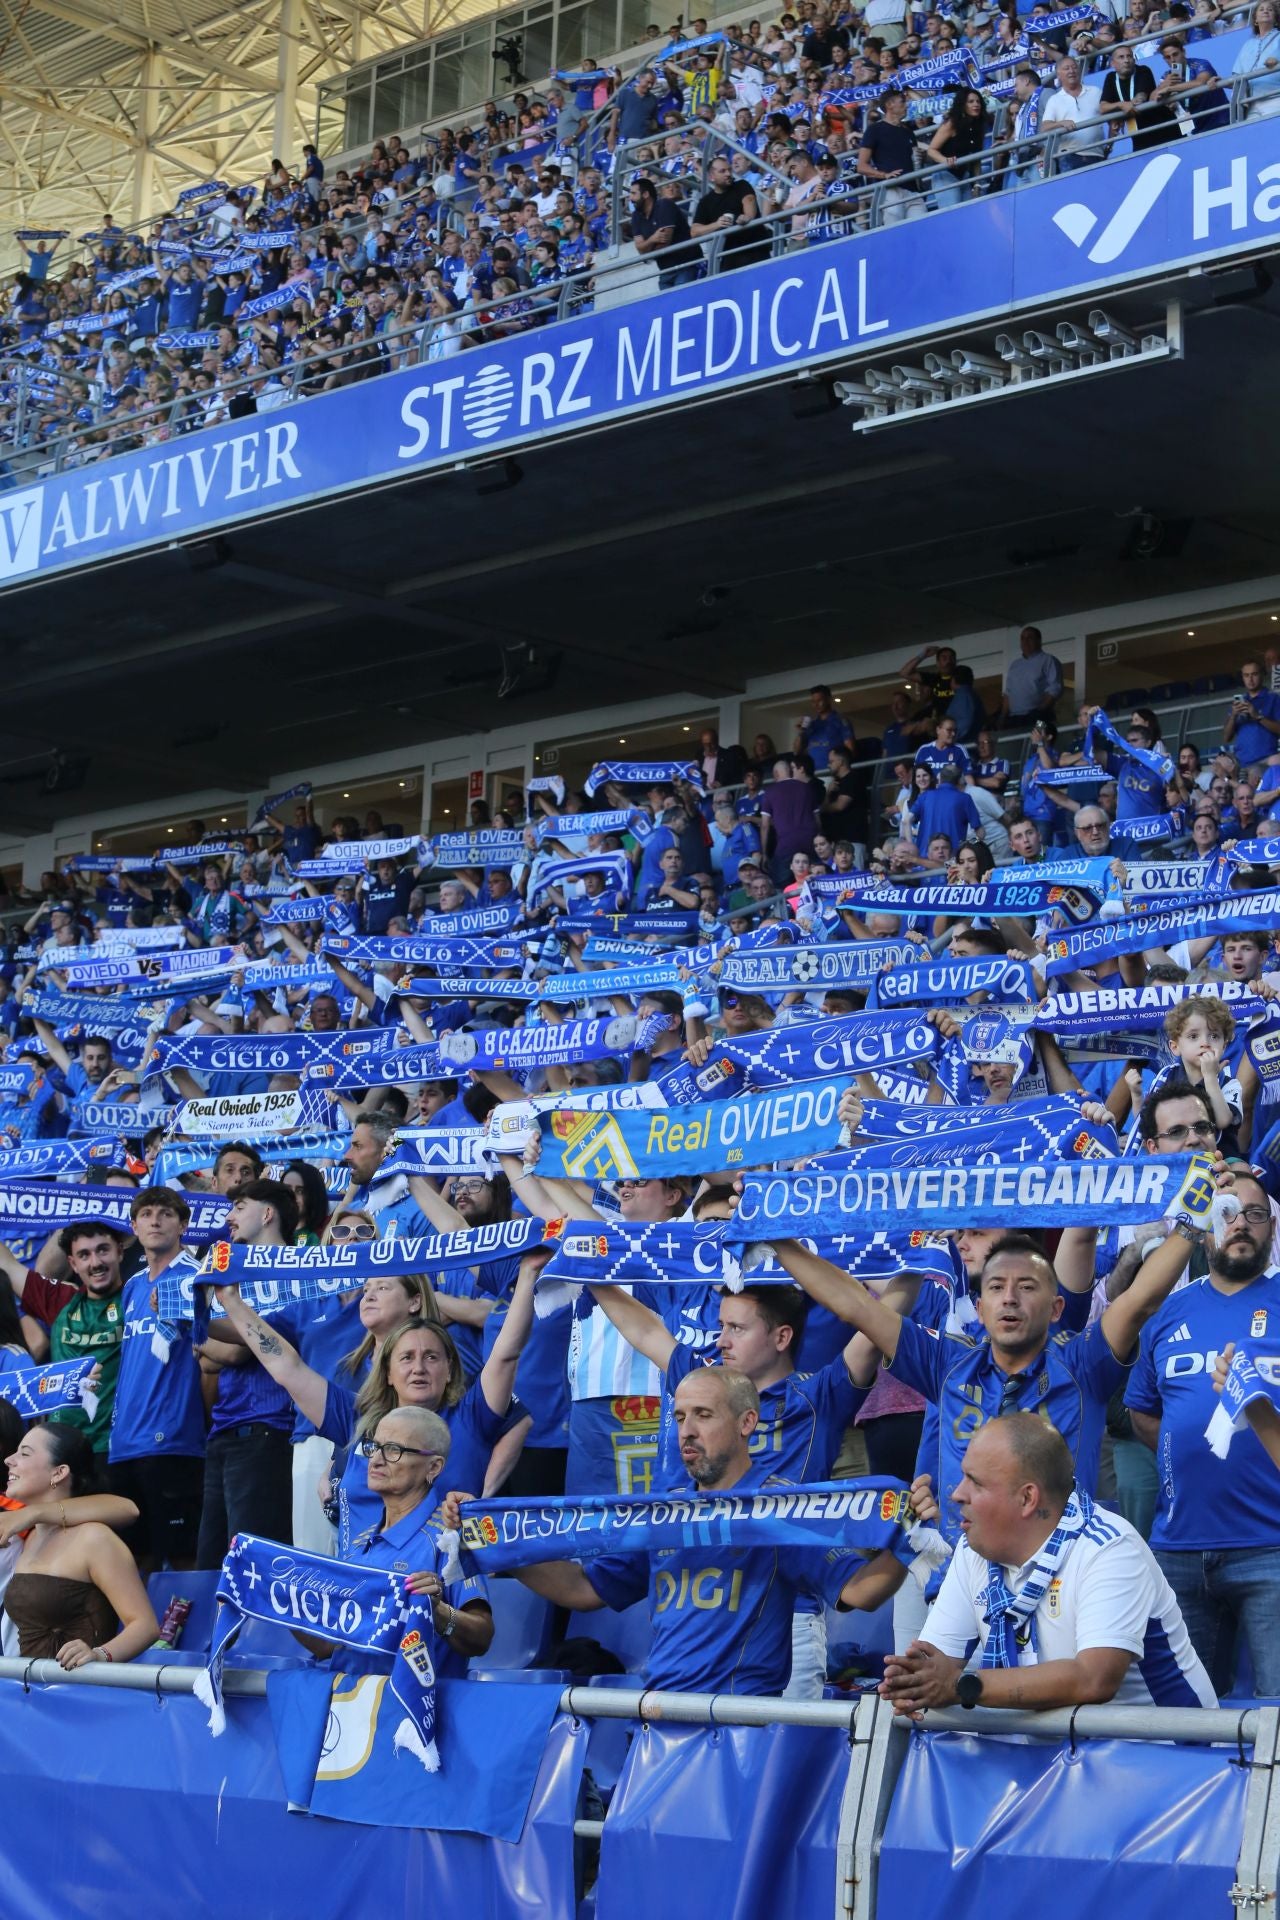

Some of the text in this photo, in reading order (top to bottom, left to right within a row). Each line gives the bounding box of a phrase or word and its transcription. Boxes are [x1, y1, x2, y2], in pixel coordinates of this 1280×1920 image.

[616, 258, 889, 401] MEDICAL
[440, 834, 468, 846] Real
[912, 886, 988, 905] OVIEDO
[993, 886, 1043, 907] 1926
[430, 908, 510, 935] Real OVIEDO
[72, 962, 131, 981] OVIEDO
[169, 950, 221, 972] MADRID
[722, 943, 915, 988] REAL OVIEDO
[38, 998, 79, 1018] REAL
[1139, 1010, 1168, 1020] NOSOTRO
[484, 1019, 598, 1056] 8 CAZORLA 8
[508, 1053, 536, 1068] ETERNO
[187, 1092, 297, 1118] Real Oviedo 1926
[646, 1108, 712, 1155] Real
[719, 1085, 837, 1146] OVIEDO
[243, 1217, 534, 1268] REAL OVIEDO
[655, 1567, 744, 1613] DIGI
